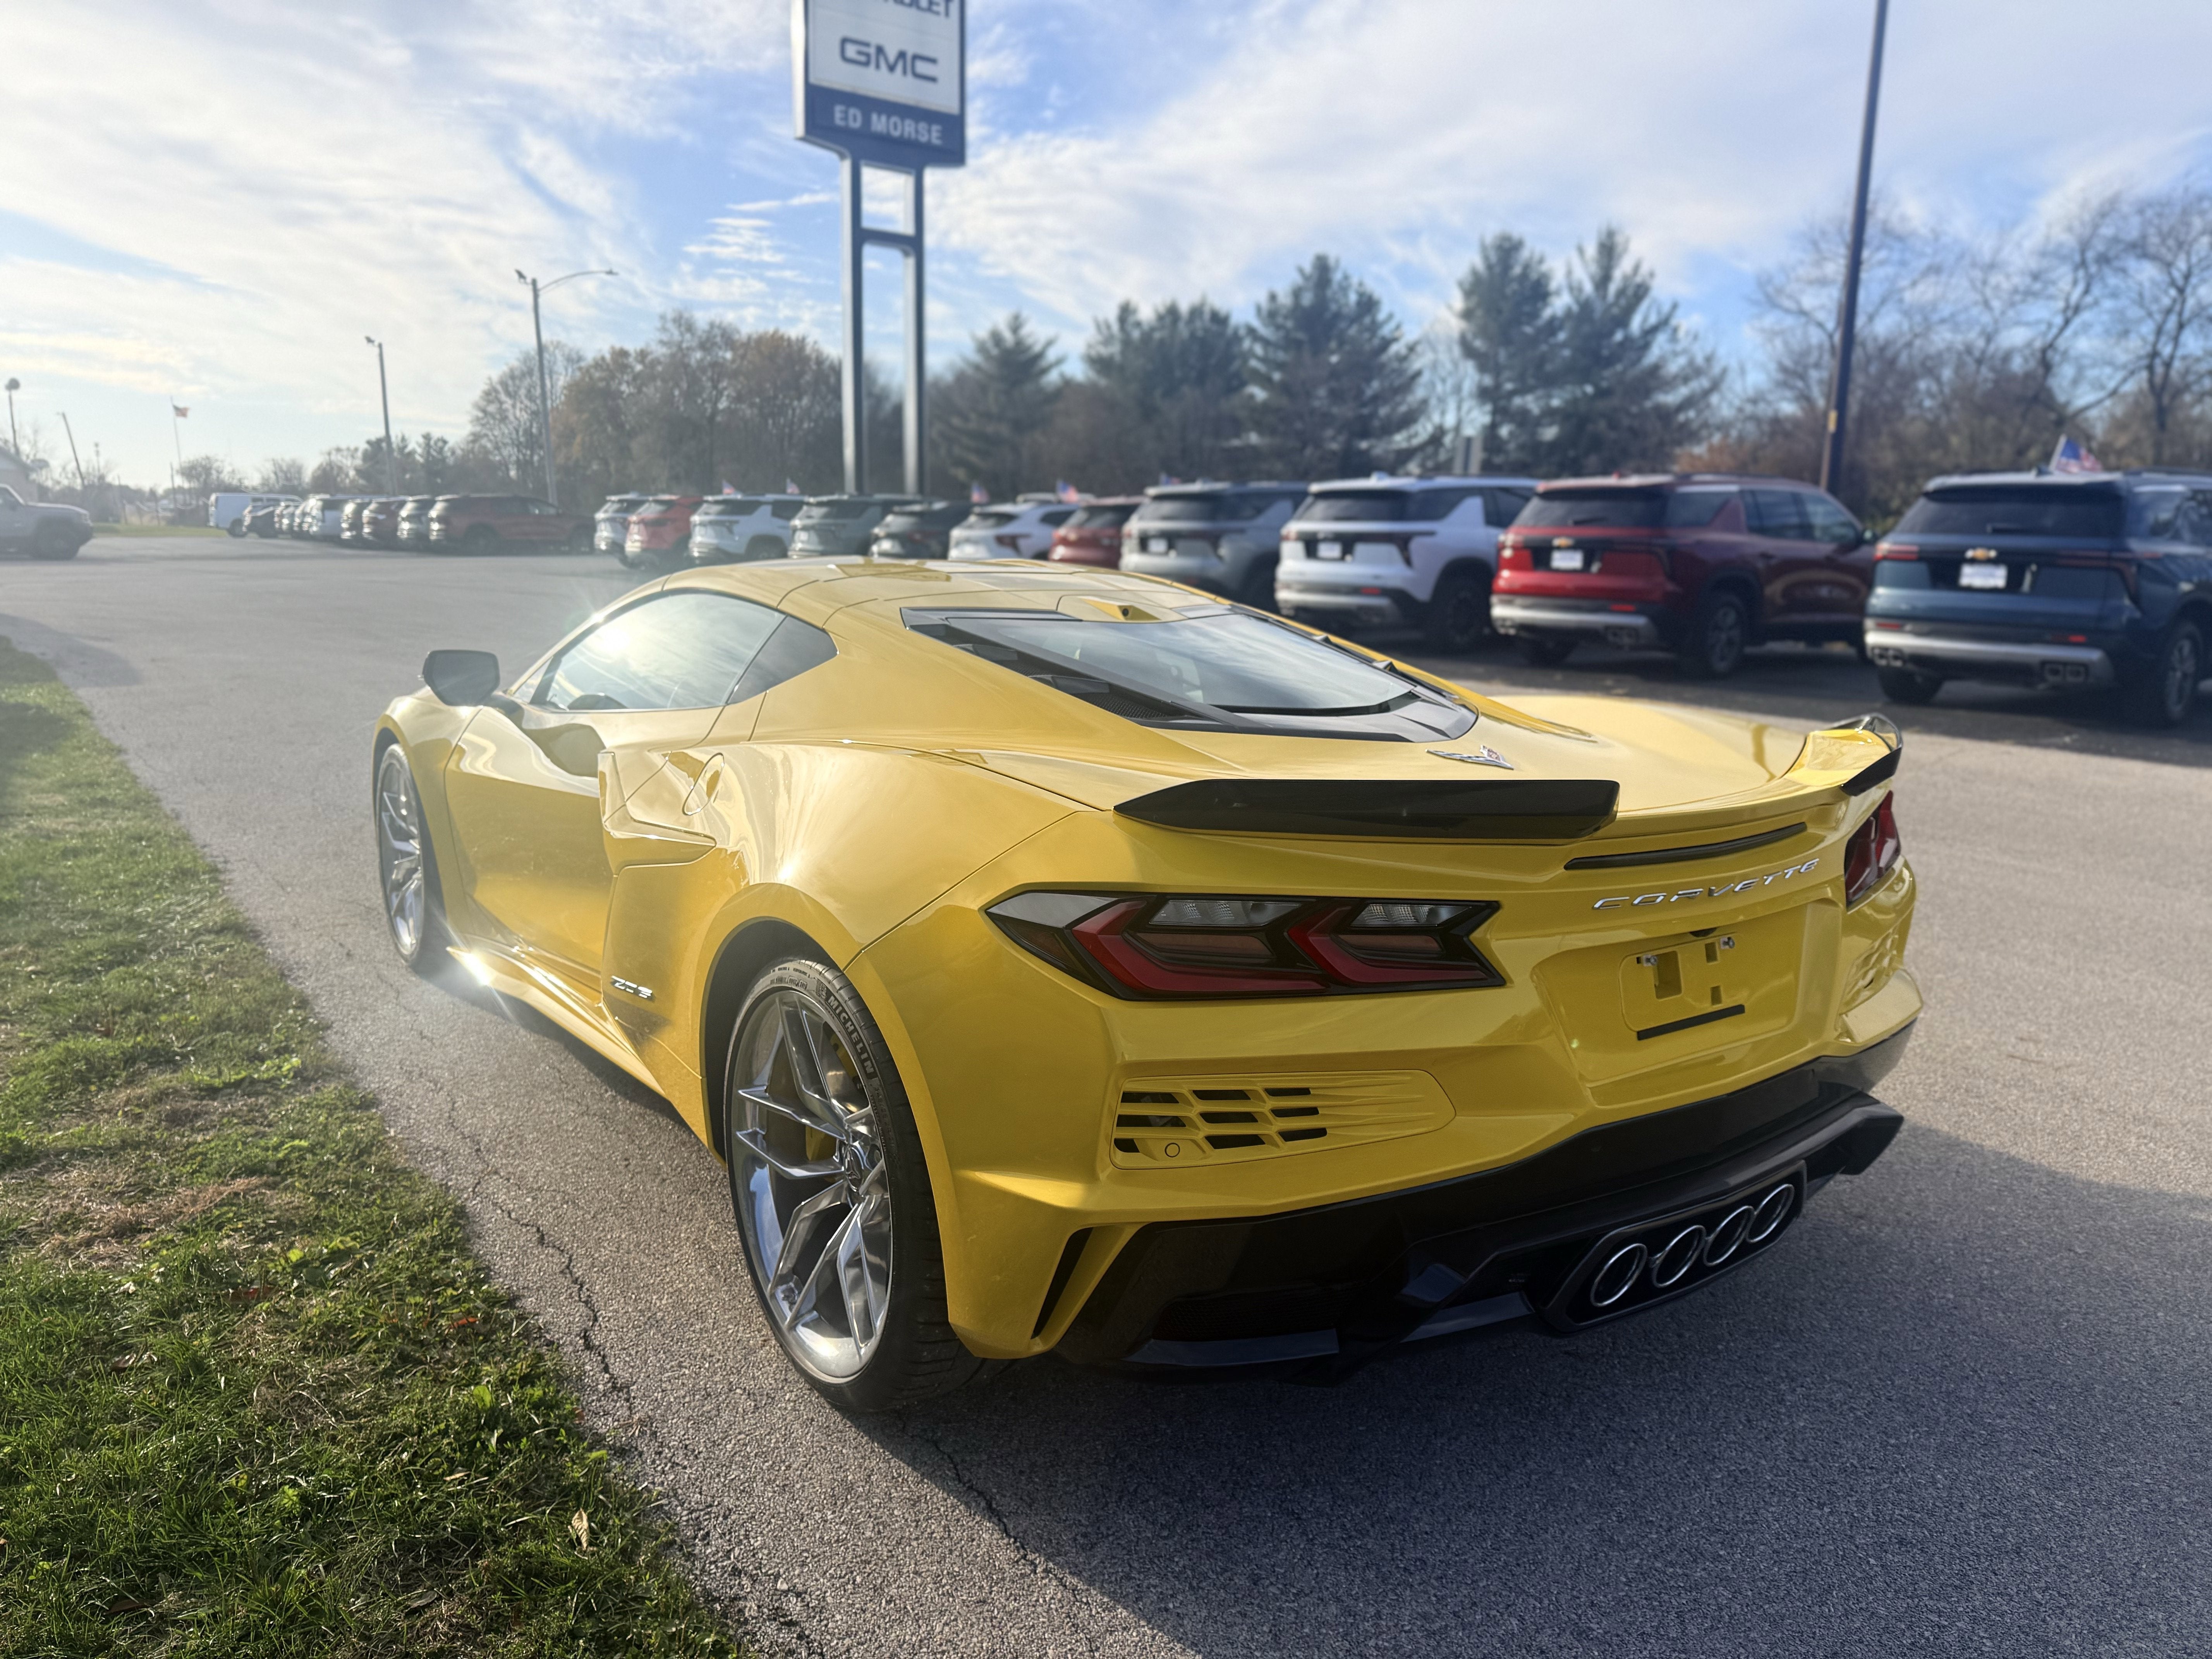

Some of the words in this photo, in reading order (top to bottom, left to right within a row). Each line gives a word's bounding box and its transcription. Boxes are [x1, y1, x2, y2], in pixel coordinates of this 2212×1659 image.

[840, 36, 938, 83] GMC
[833, 104, 862, 129] ED
[870, 112, 943, 145] MORSE
[1592, 858, 1819, 910] CORVETTE
[828, 995, 875, 1074] MICHELIN
